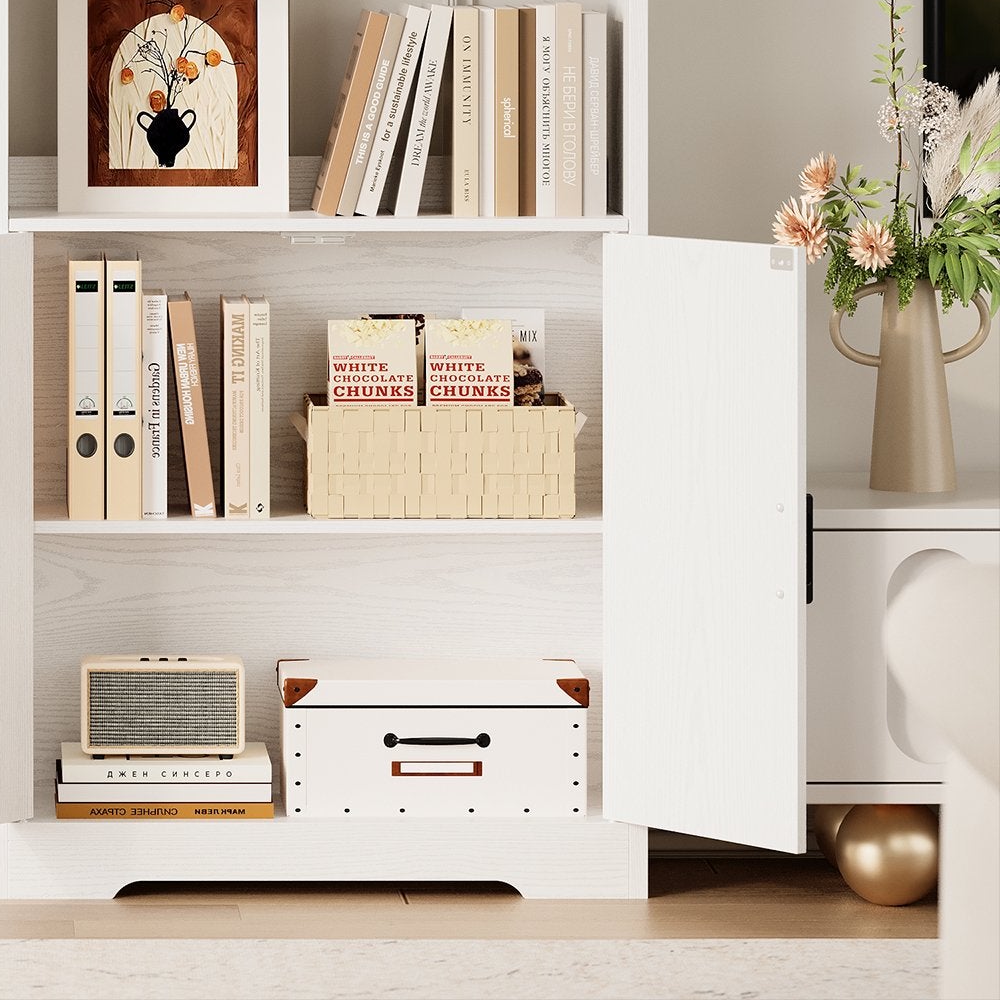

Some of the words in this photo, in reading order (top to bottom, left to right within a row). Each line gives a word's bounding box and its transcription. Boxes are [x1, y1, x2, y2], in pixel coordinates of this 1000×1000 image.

[462, 36, 471, 52] ON
[542, 45, 550, 73] МОГУ
[381, 129, 391, 142] for
[389, 68, 408, 119] sustainable
[402, 31, 418, 66] lifestyle
[562, 66, 576, 84] НЕ
[588, 56, 600, 88] ДАВИД
[462, 59, 471, 127] IMMUNITY
[542, 78, 550, 140] ОБЪЯСНИТЬ
[562, 87, 576, 120] БЕРИ
[355, 142, 368, 165] THIS
[363, 132, 370, 142] IS
[368, 91, 381, 121] GOOD
[376, 59, 390, 90] GUIDE
[411, 128, 425, 166] DREAM
[424, 60, 437, 96] AWAKE
[501, 97, 515, 138] spherical
[562, 124, 576, 132] В
[590, 90, 600, 175] СЕРВАН-ШРЕЙБЕР
[542, 143, 550, 186] МНОГОЕ
[562, 135, 576, 186] ГОЛОВУ
[520, 330, 537, 342] MIX
[333, 363, 388, 372] WHITE
[430, 363, 485, 372] WHITE
[333, 385, 414, 397] CHUNKS
[430, 385, 511, 397] CHUNKS
